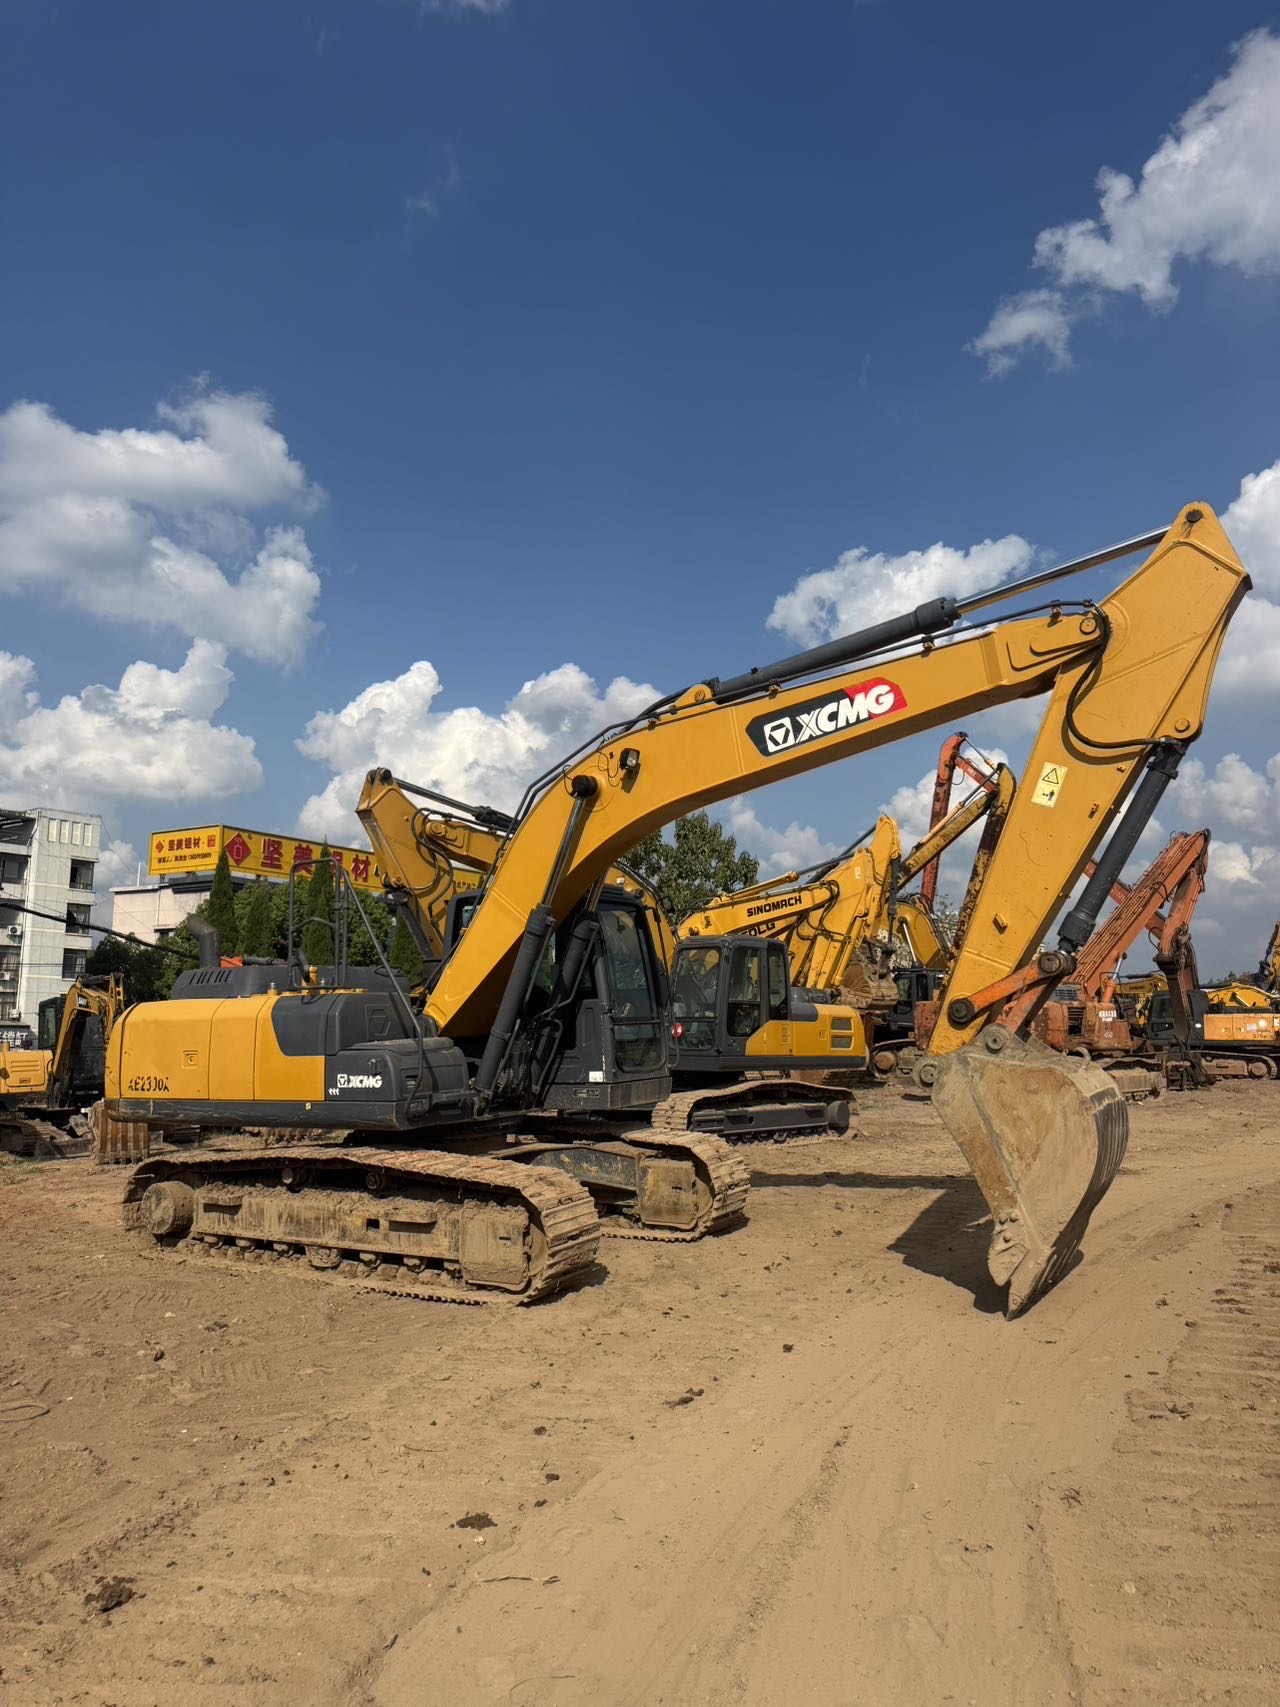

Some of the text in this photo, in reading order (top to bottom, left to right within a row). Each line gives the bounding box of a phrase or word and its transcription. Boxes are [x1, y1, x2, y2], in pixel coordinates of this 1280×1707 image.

[795, 684, 895, 743] XCMG
[747, 896, 802, 917] SINOMACH
[347, 1074, 383, 1088] XCMG
